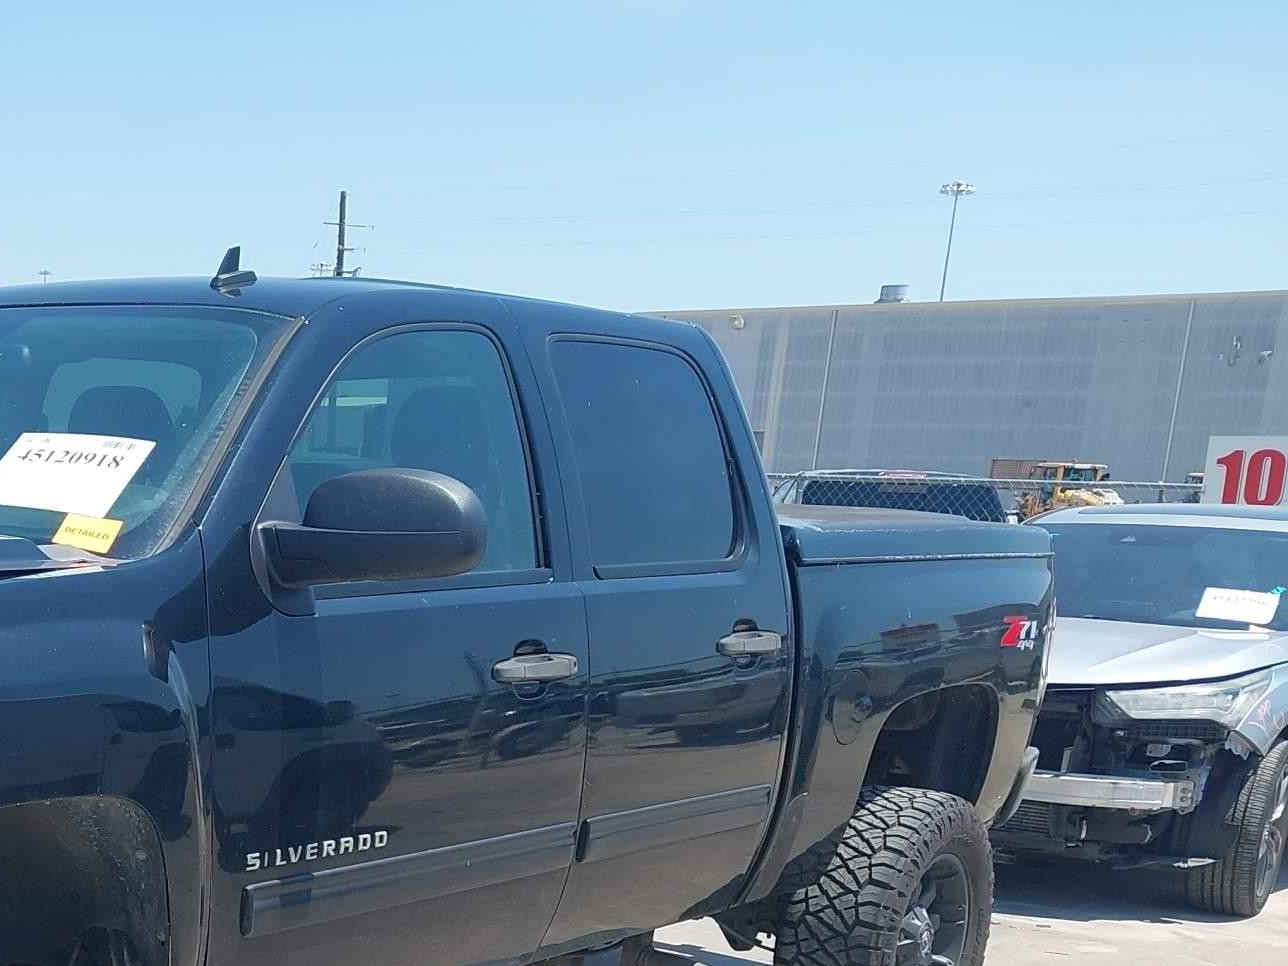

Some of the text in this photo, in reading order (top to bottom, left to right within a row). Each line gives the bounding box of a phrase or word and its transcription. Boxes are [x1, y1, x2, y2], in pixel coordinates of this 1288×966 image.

[17, 448, 125, 469] 45120918
[1216, 448, 1288, 507] 10
[64, 526, 110, 540] DETAILED
[245, 830, 389, 872] SILVERADO
